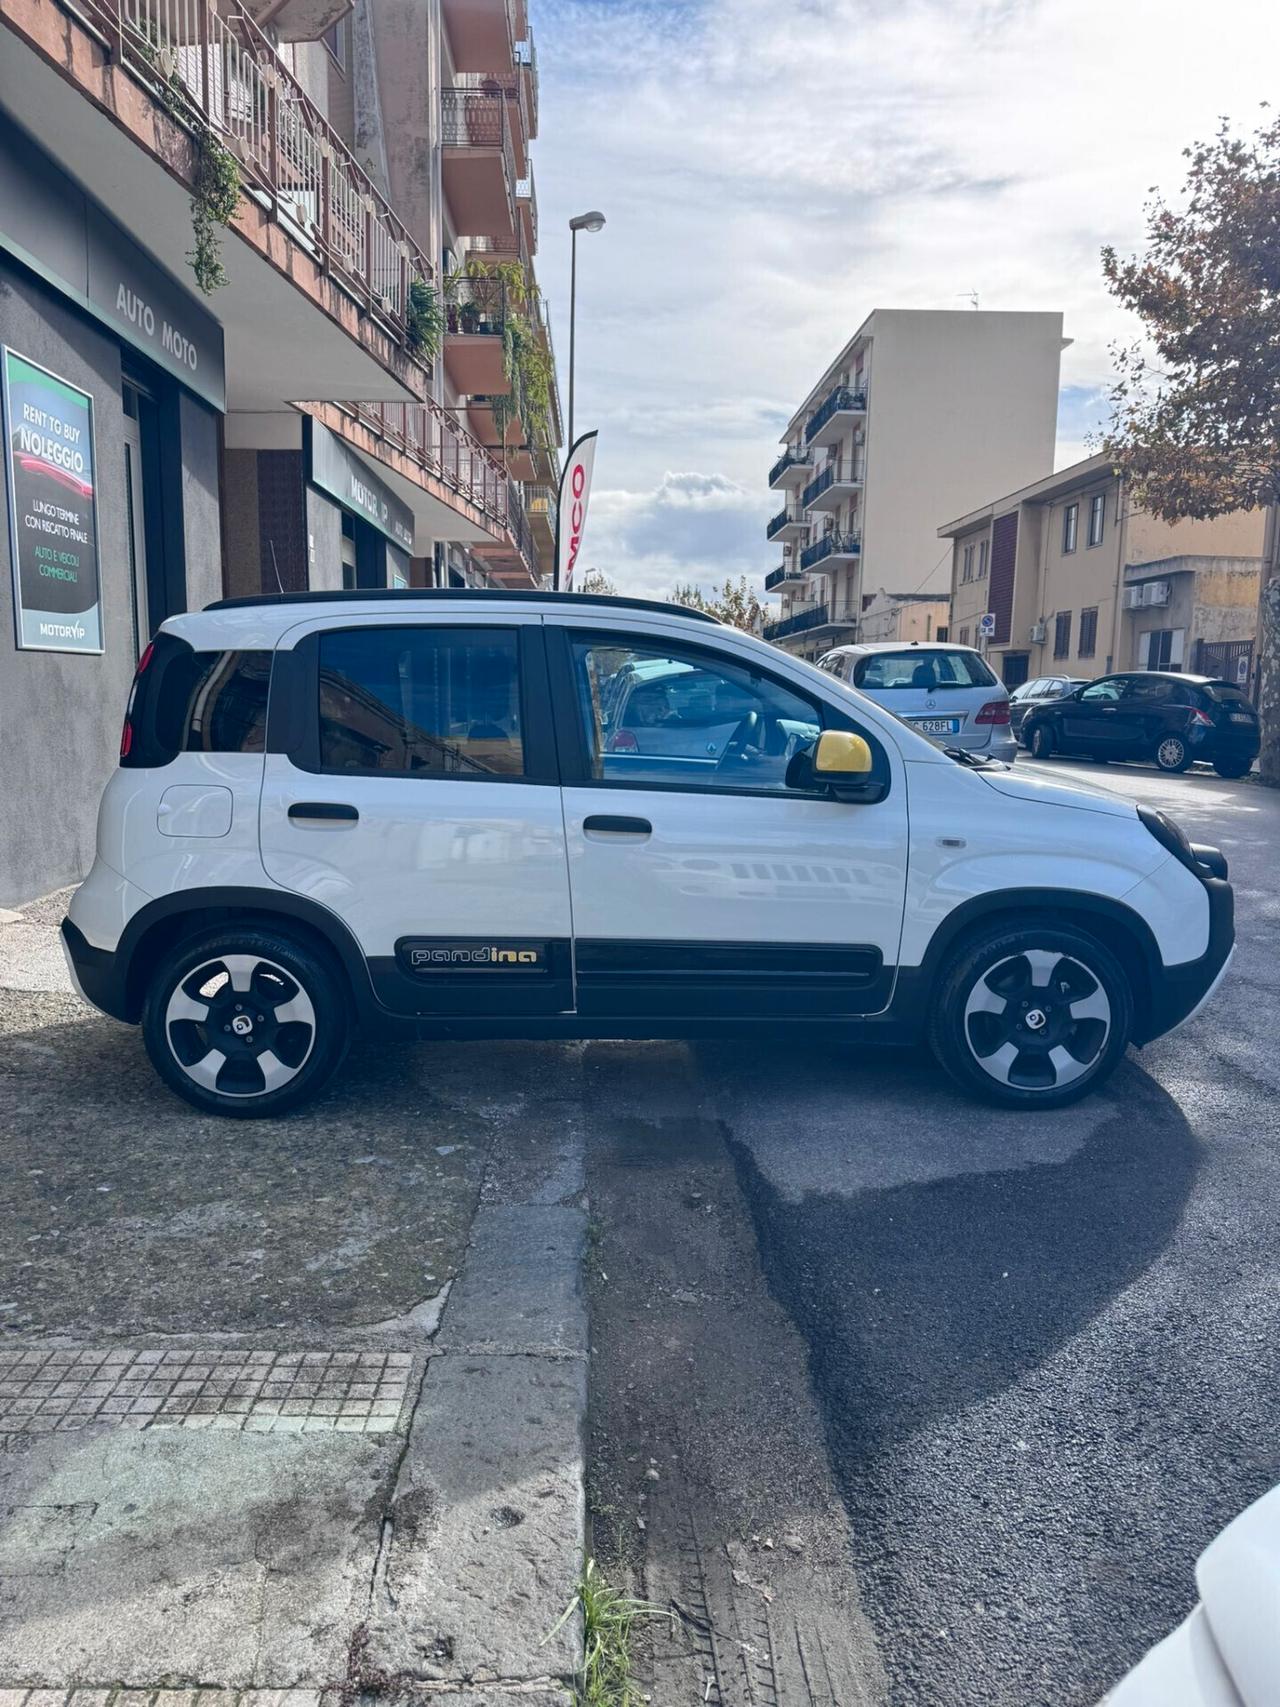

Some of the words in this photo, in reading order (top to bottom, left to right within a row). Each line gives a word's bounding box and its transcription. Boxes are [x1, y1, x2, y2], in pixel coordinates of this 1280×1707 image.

[116, 283, 154, 336] AUTO
[162, 321, 197, 370] MOTO
[23, 403, 47, 428] RENT
[49, 415, 61, 435] TO
[63, 424, 80, 444] BUY
[20, 427, 83, 473] NOLEGGIO
[33, 499, 56, 517] LUNGO
[56, 507, 80, 525] TERMINE
[25, 515, 41, 531] CON
[42, 519, 69, 538] RISCATTO
[70, 528, 88, 544] FINALE
[35, 545, 52, 560] AUTO
[411, 947, 537, 965] pandina
